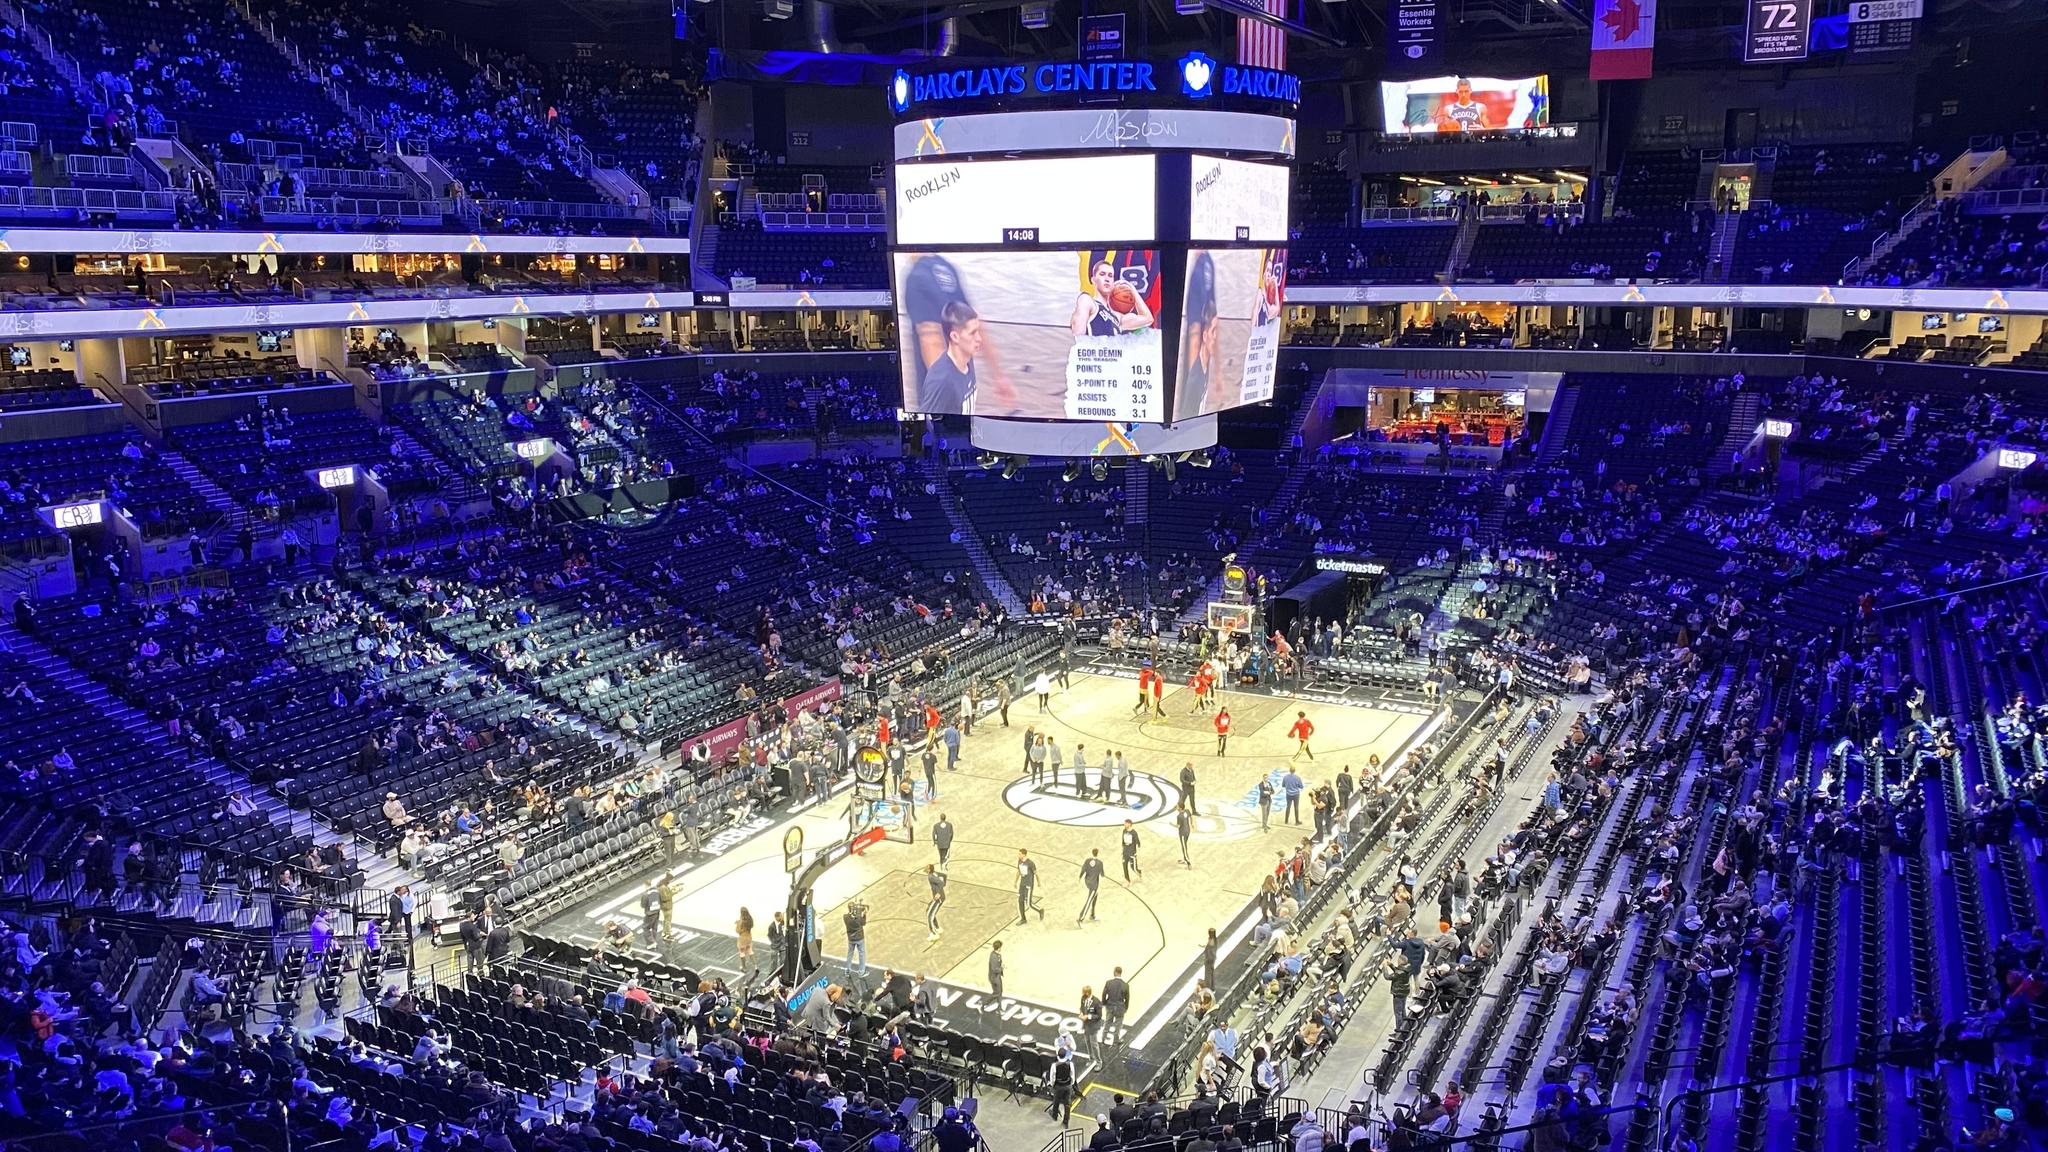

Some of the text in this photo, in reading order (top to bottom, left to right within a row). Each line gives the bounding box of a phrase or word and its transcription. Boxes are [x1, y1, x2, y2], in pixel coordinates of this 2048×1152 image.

[1858, 4, 1869, 19] 8
[1871, 2, 1894, 10] SOLD
[1399, 8, 1435, 18] Essential
[1761, 4, 1797, 29] 72
[1871, 10, 1902, 18] SHOWS
[1399, 18, 1432, 26] Workers
[914, 62, 1156, 102] BARCLAYS CENTER
[1223, 66, 1299, 103] BARCLAYS
[793, 137, 808, 145] 212
[1326, 135, 1341, 143] 215
[905, 167, 961, 203] ROOKLYN
[1195, 163, 1222, 197] ROOKLYN
[1007, 229, 1034, 241] 14:08
[1077, 348, 1096, 357] EGOR
[1076, 364, 1151, 375] POINTS 10.9
[1076, 379, 1152, 390] 3-POINT FG 40%
[1077, 393, 1147, 404] ASSISTS 3.3
[1078, 407, 1146, 418] REBOUNDS 3.1
[1316, 559, 1385, 575] ticketmaster
[795, 686, 836, 711] QATAR AIRWAYS
[1377, 702, 1434, 716] Nets
[711, 728, 738, 745] AIRWAYS
